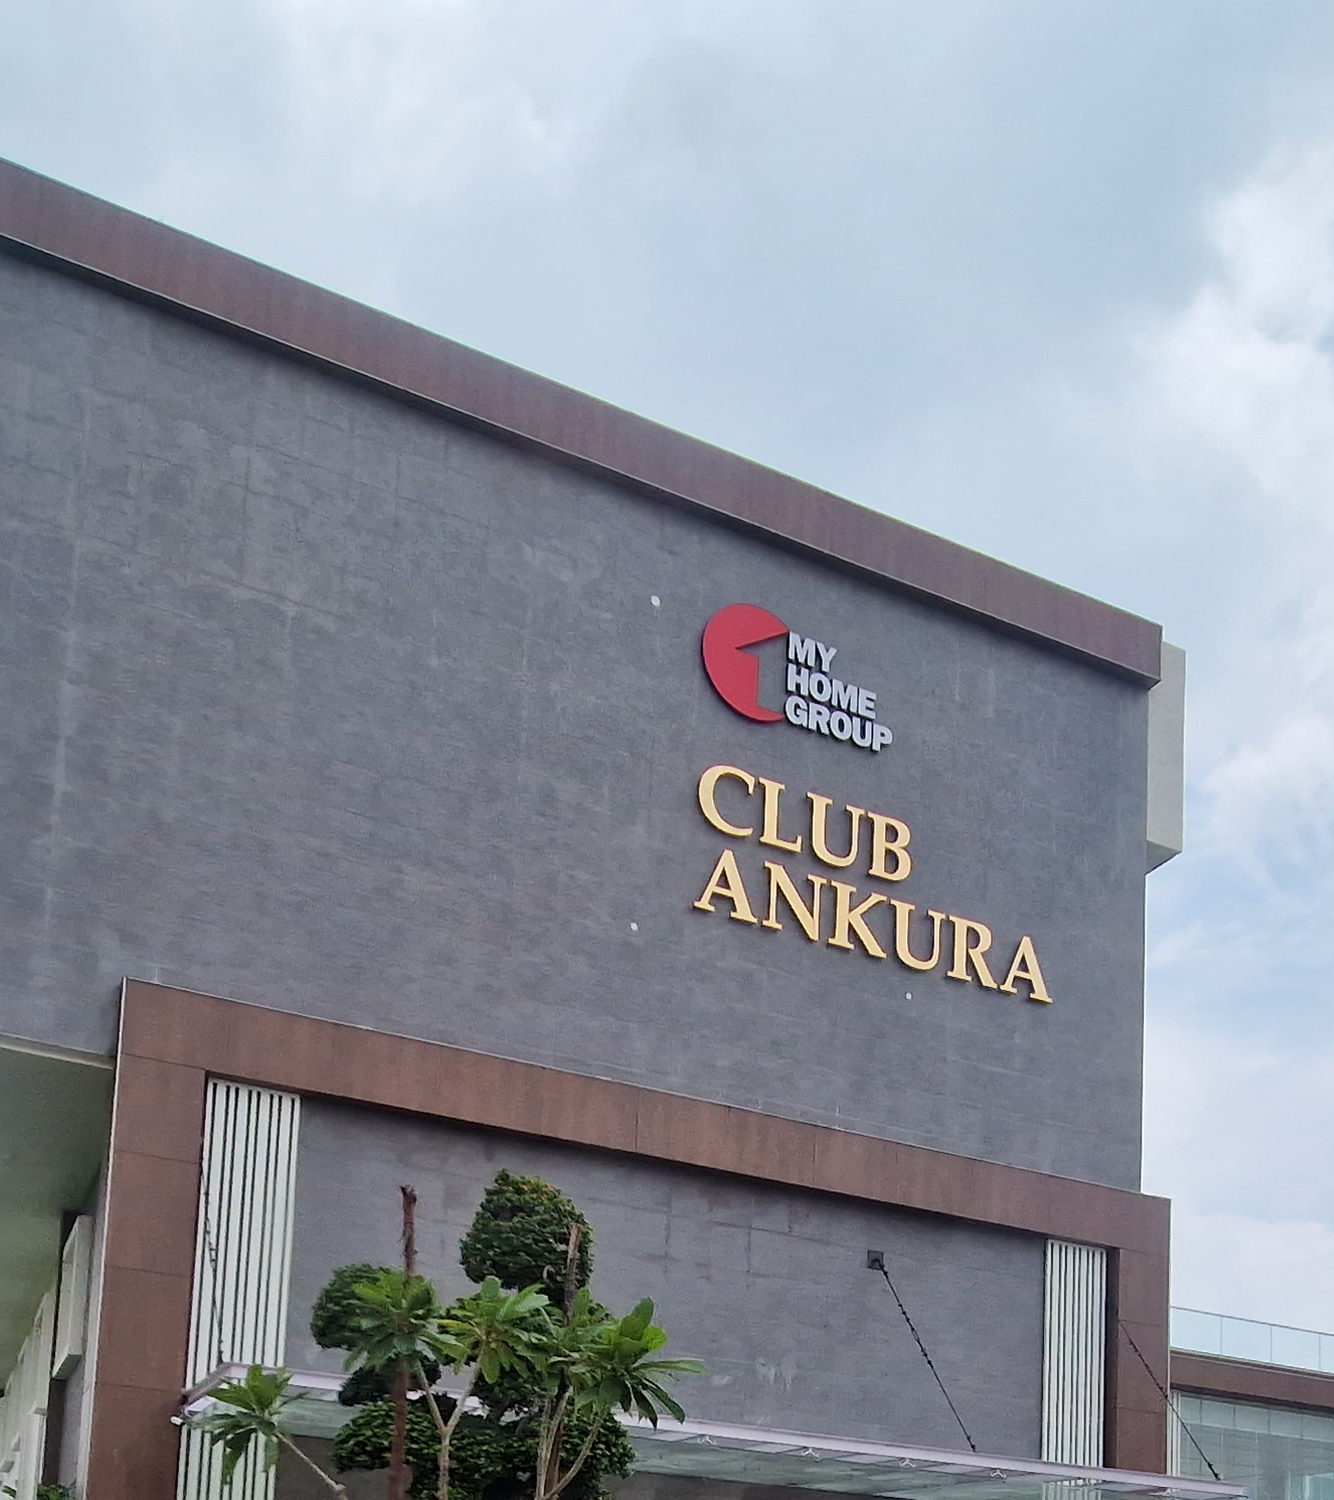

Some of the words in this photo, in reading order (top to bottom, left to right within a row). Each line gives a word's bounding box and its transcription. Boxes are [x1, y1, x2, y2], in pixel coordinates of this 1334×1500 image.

[787, 632, 837, 672] MY
[786, 664, 877, 719] HOME
[784, 696, 893, 752] GROUP
[698, 765, 912, 881] CLUB
[693, 849, 1053, 1004] ANKURA
